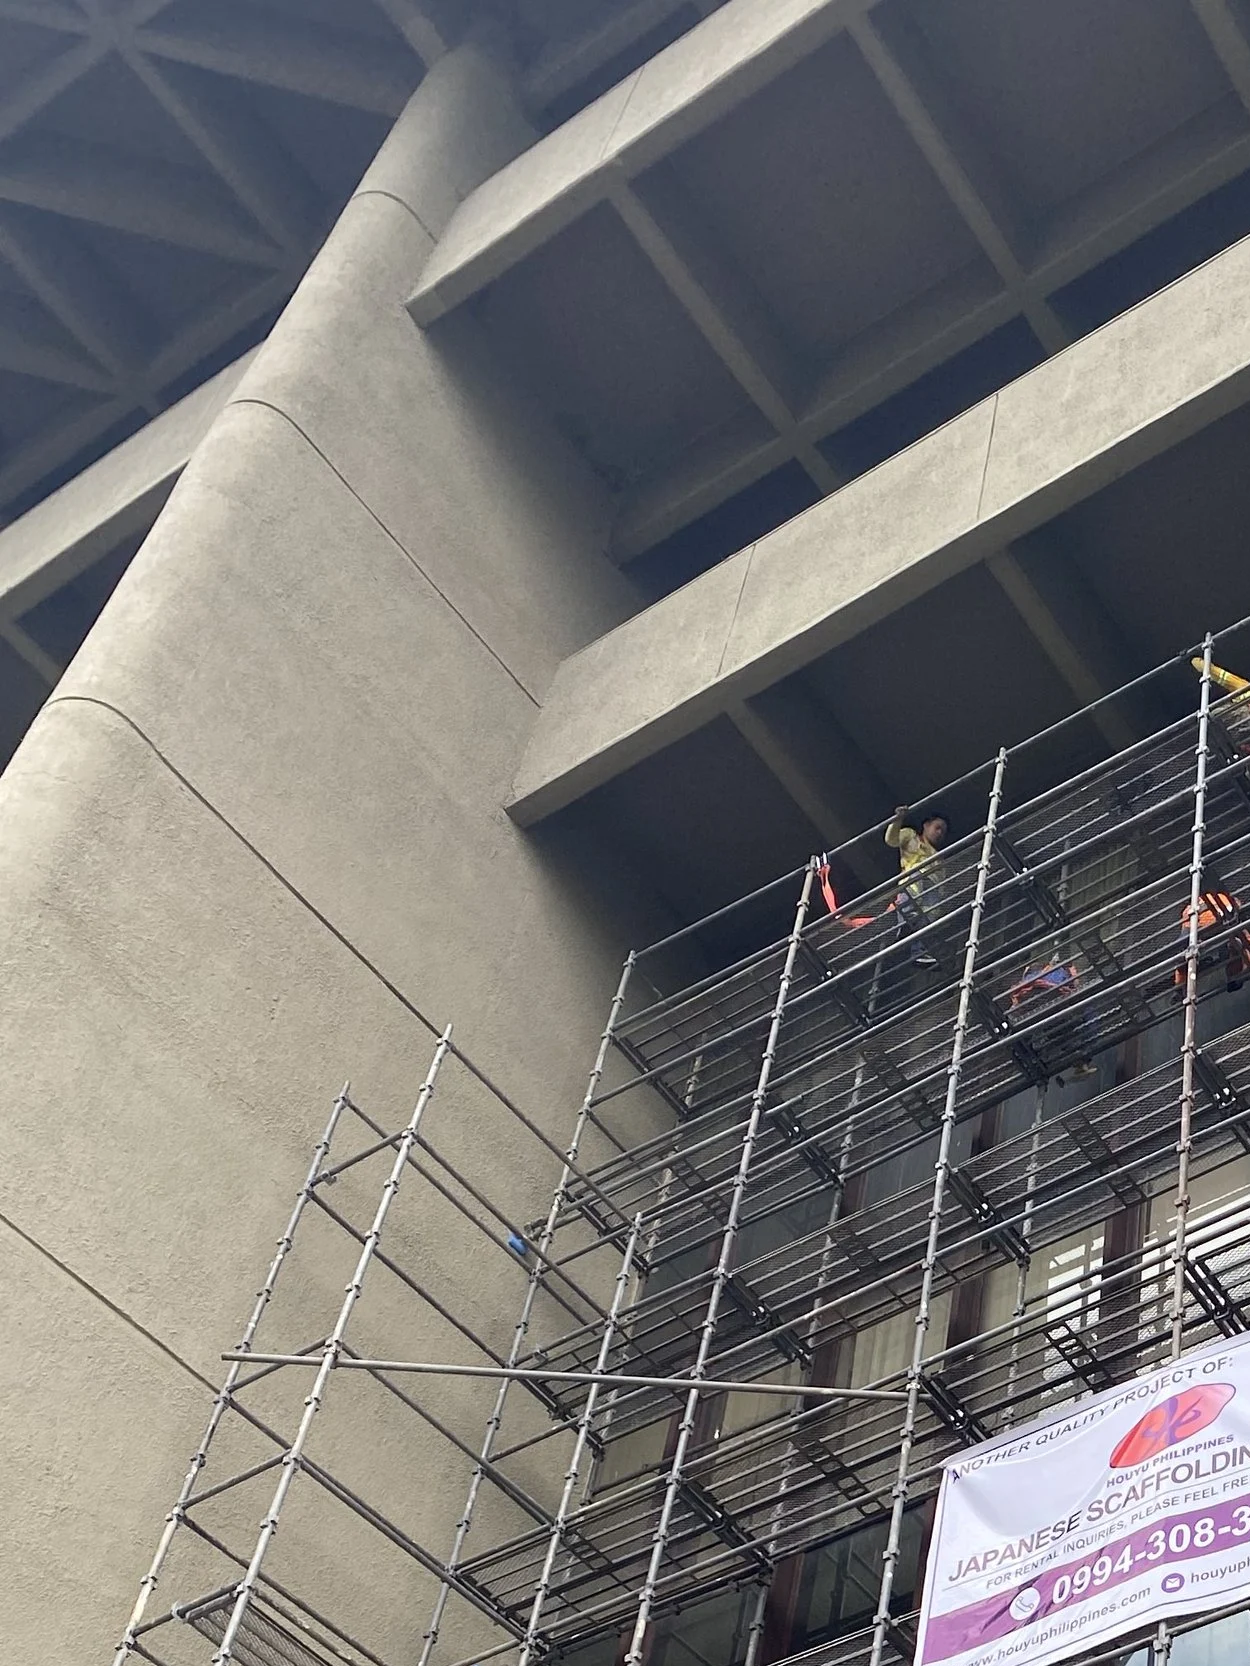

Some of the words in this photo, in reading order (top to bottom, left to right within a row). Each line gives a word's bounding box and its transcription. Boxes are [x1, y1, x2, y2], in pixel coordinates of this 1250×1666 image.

[952, 1441, 1031, 1483] ANOTHER
[1035, 1405, 1110, 1446] QUALITY
[1113, 1368, 1196, 1410] PROJECT
[1202, 1356, 1233, 1375] OF:
[1106, 1462, 1150, 1488] HOUYU
[1152, 1434, 1234, 1467] PHILIPPINES
[948, 1510, 1082, 1582] JAPANESE
[986, 1572, 1012, 1589] FOR
[1015, 1552, 1059, 1578] RENTAL
[1063, 1520, 1127, 1554] INQUIRIES,
[1131, 1496, 1181, 1524] PLEASE
[1184, 1487, 1218, 1503] FEEL
